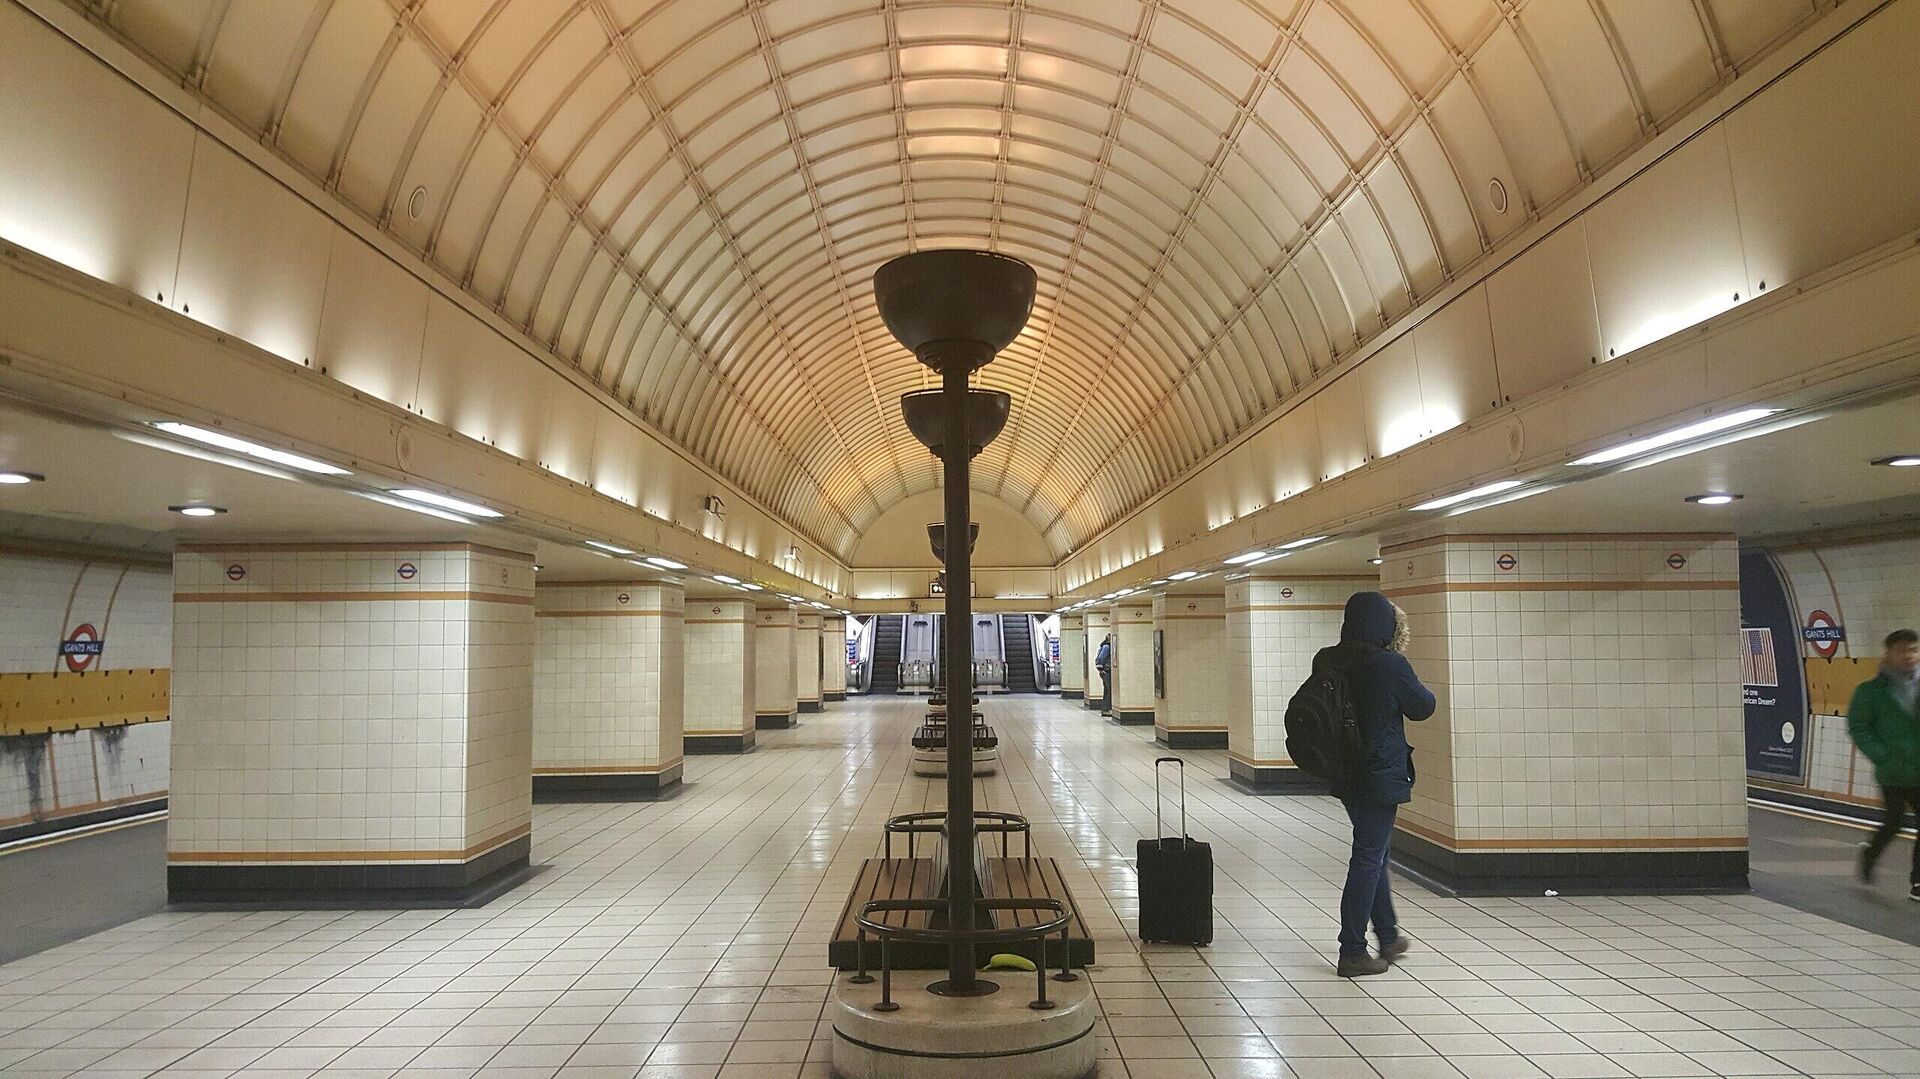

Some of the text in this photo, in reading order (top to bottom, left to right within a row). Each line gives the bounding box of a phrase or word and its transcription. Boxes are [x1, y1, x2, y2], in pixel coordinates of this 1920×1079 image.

[1805, 630, 1841, 639] GANTS HILL
[64, 643, 99, 652] GANTS HILL
